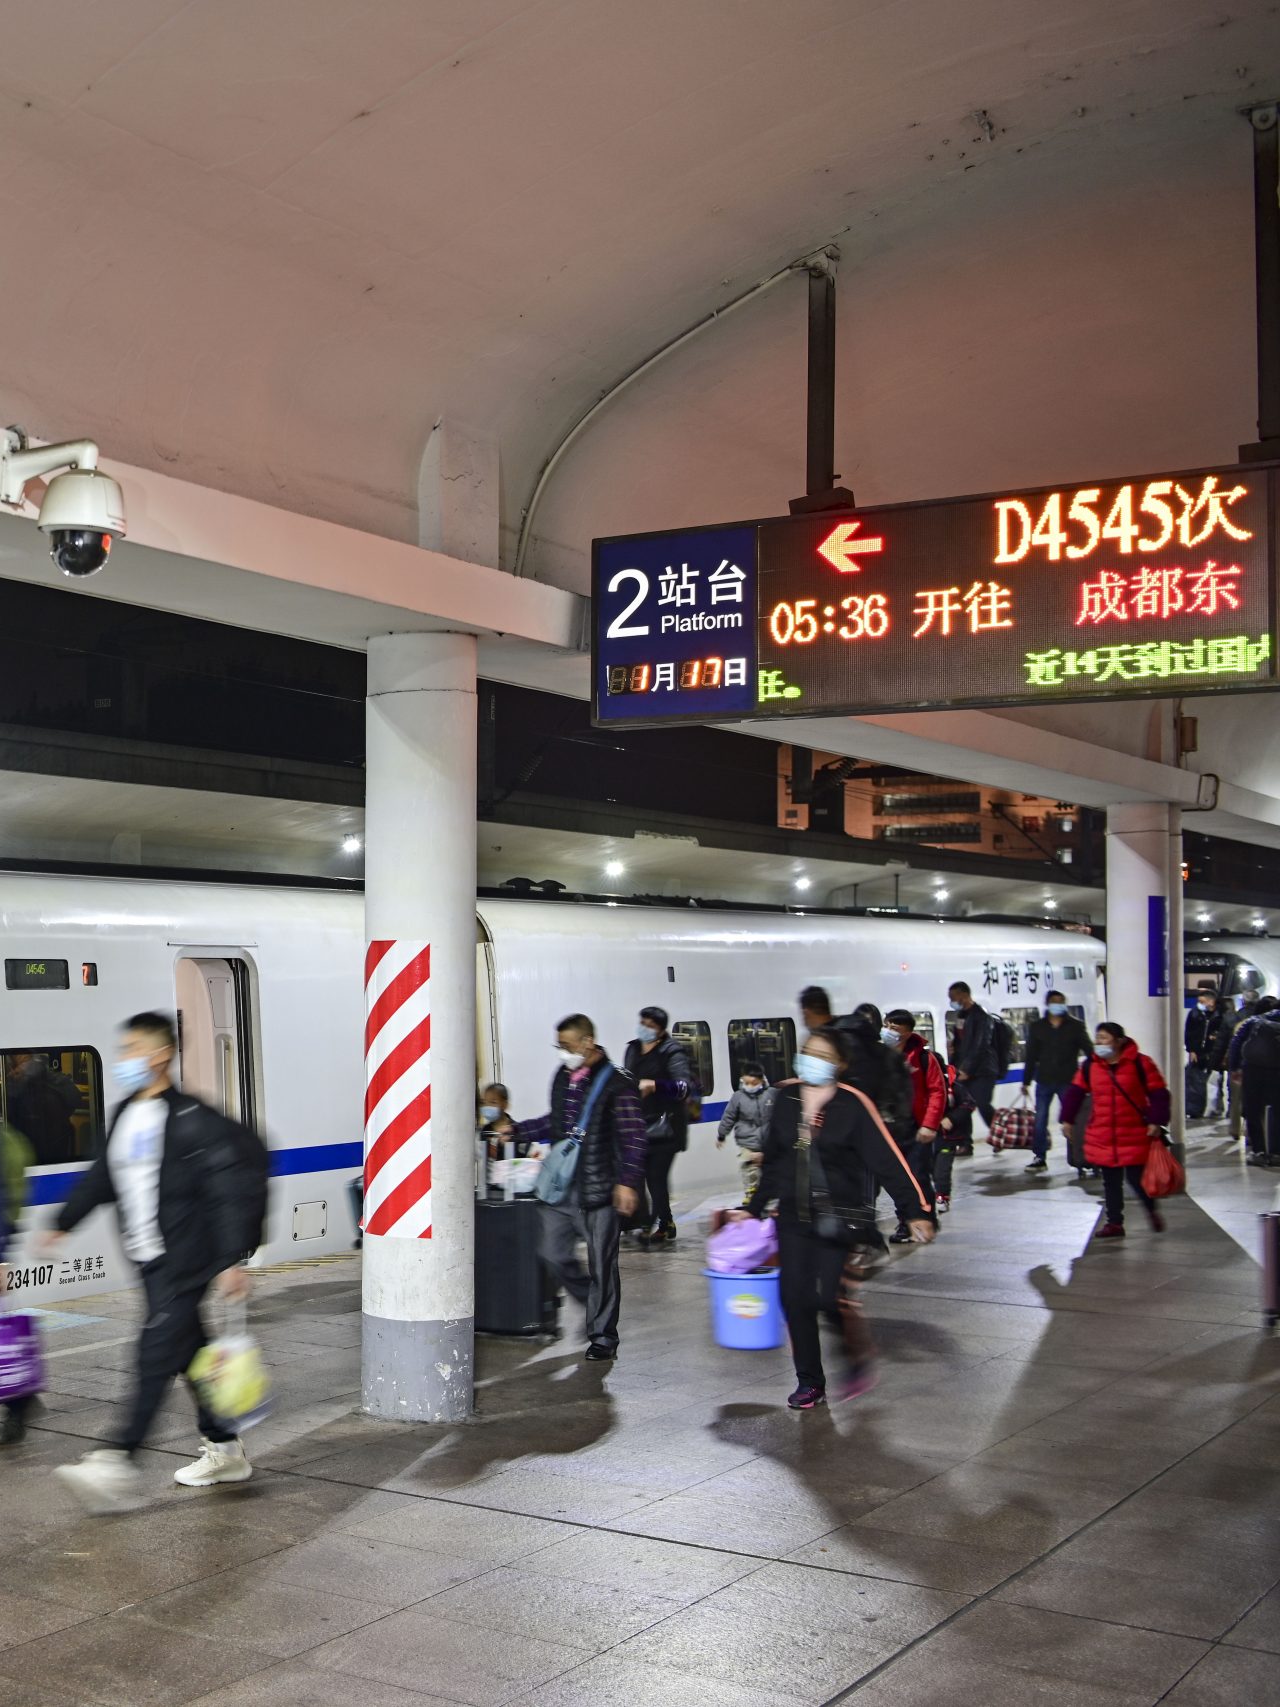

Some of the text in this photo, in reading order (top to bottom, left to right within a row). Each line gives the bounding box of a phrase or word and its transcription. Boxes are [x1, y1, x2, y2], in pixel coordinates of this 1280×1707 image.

[993, 476, 1253, 564] D4545次
[607, 559, 747, 639] 2 站台
[1075, 560, 1242, 626] 成都东
[661, 611, 743, 634] Platform
[770, 581, 1014, 645] 05:36 开往
[982, 960, 1040, 995] 和谐号
[6, 1265, 53, 1291] 234107
[59, 1271, 106, 1285] Second Class Coach
[61, 1255, 104, 1274] 二等座车
